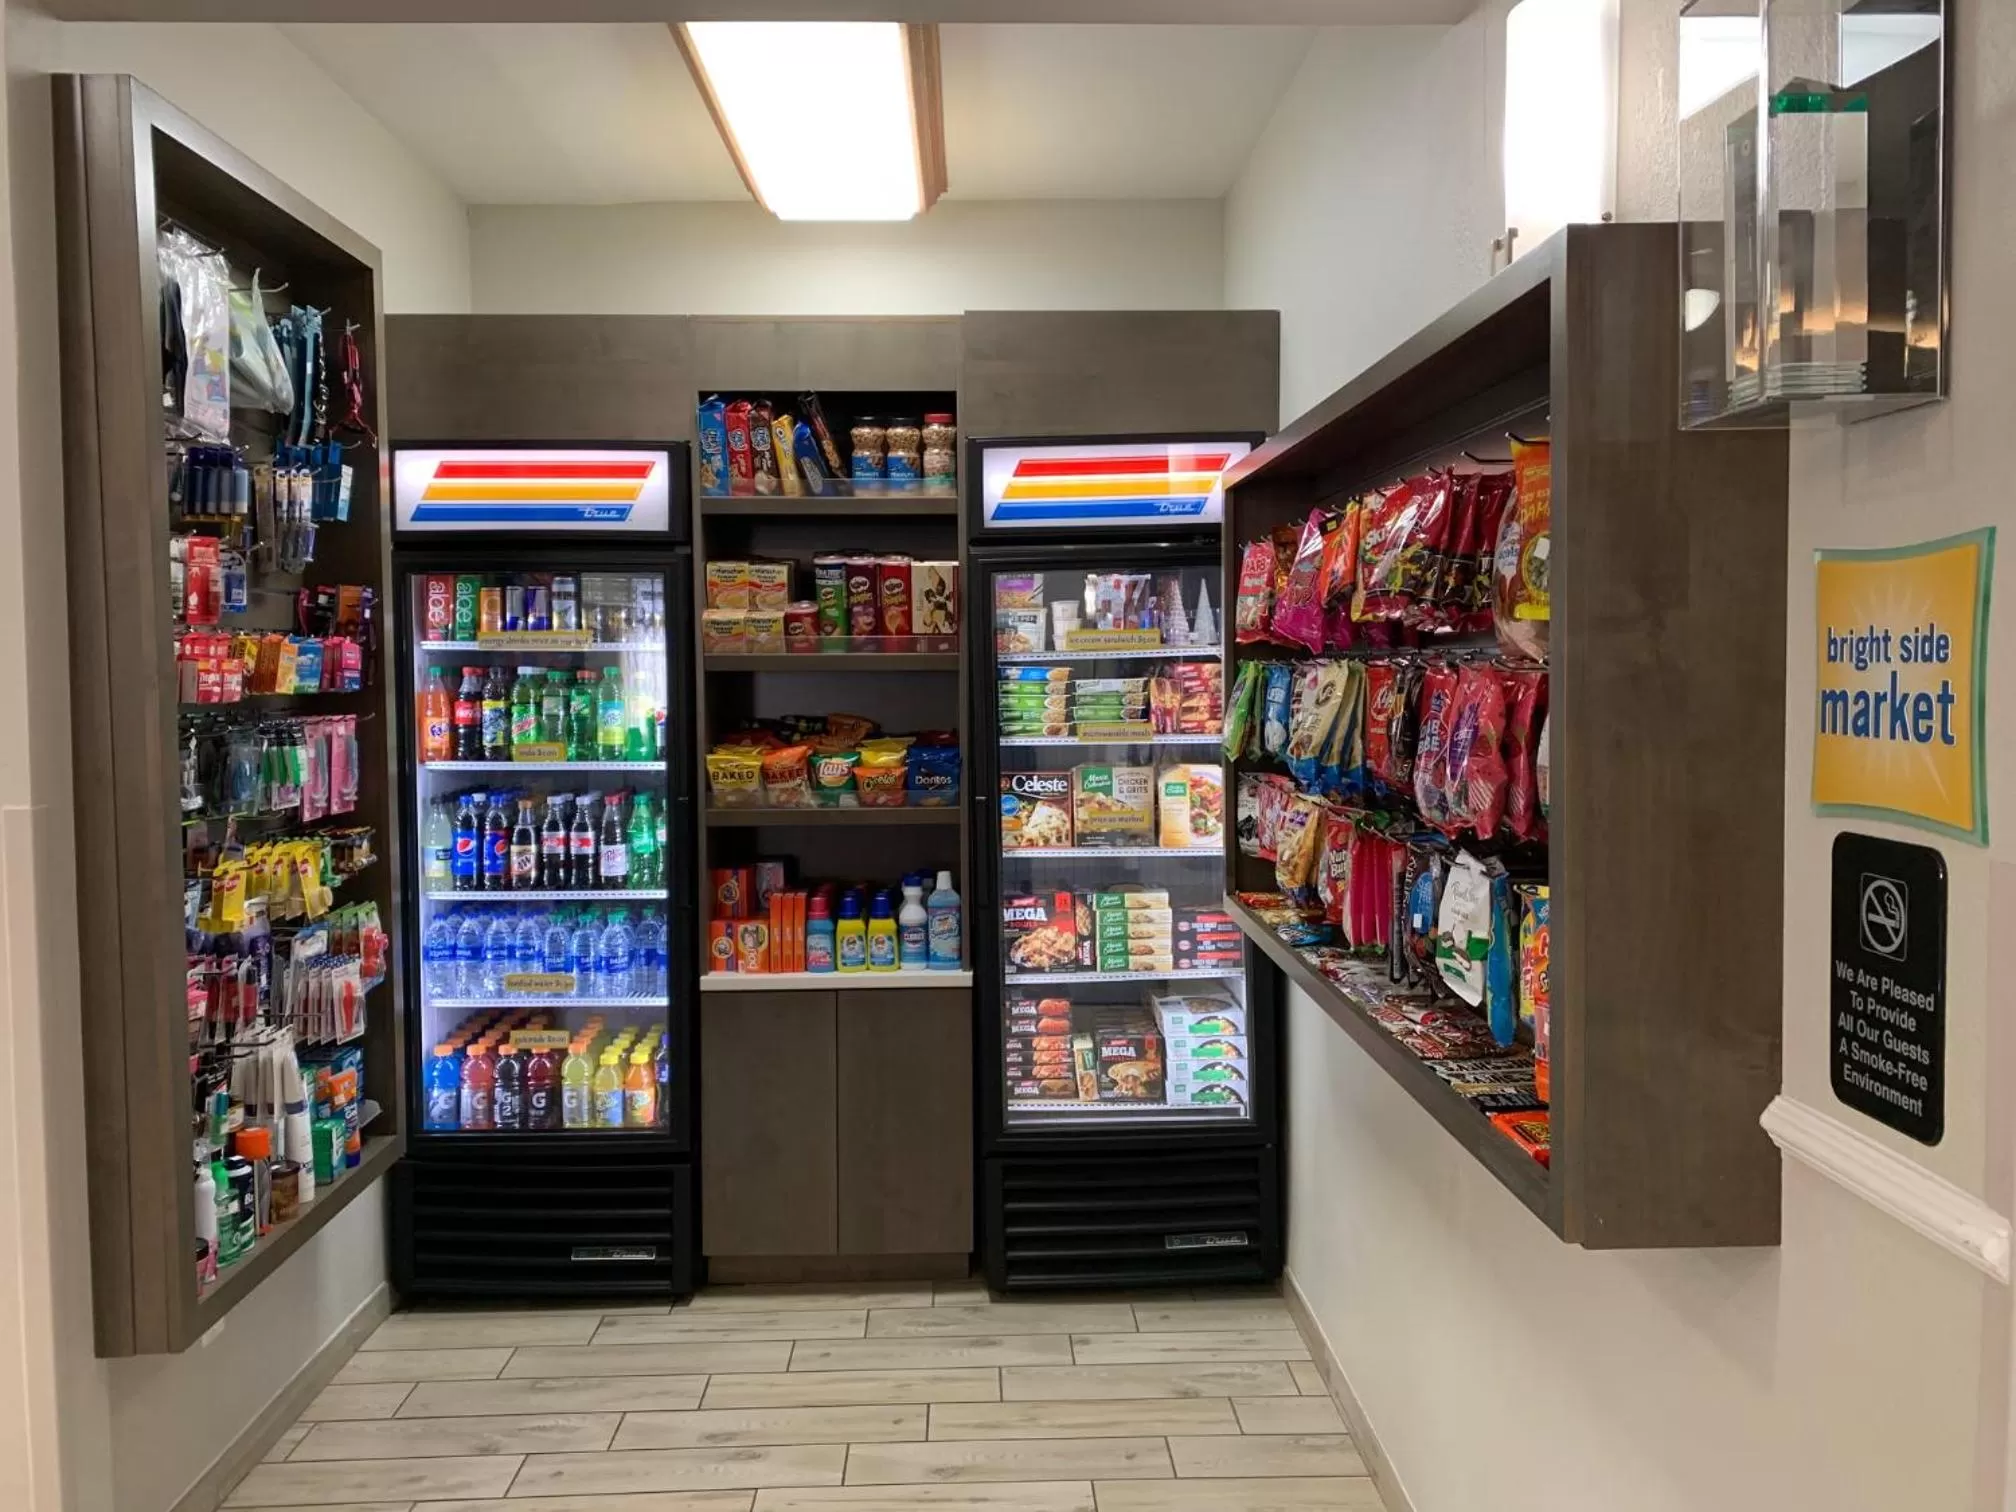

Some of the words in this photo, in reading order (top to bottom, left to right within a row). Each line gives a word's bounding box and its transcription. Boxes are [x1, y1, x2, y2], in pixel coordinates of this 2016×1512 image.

[1827, 624, 1892, 671] bright
[1900, 622, 1950, 664] side
[1820, 670, 1956, 746] market
[712, 770, 755, 781] BAKED
[915, 775, 953, 786] Doritos
[1012, 775, 1068, 793] Celeste
[1117, 778, 1149, 786] CHICKEN
[1003, 907, 1048, 922] MEGA
[1836, 960, 1855, 982] We
[1857, 967, 1878, 991] Are
[1881, 976, 1935, 1012] Pleased
[1849, 990, 1864, 1011] To
[1867, 994, 1917, 1033] Provide
[1102, 1046, 1136, 1058] MEGA
[1837, 1012, 1855, 1033] All
[1857, 1018, 1880, 1044] Our
[1883, 1029, 1931, 1065] Guests
[1839, 1037, 1849, 1055] A
[1851, 1042, 1929, 1092] Smoke-Free
[531, 1091, 546, 1107] G
[1843, 1063, 1923, 1118] Environment
